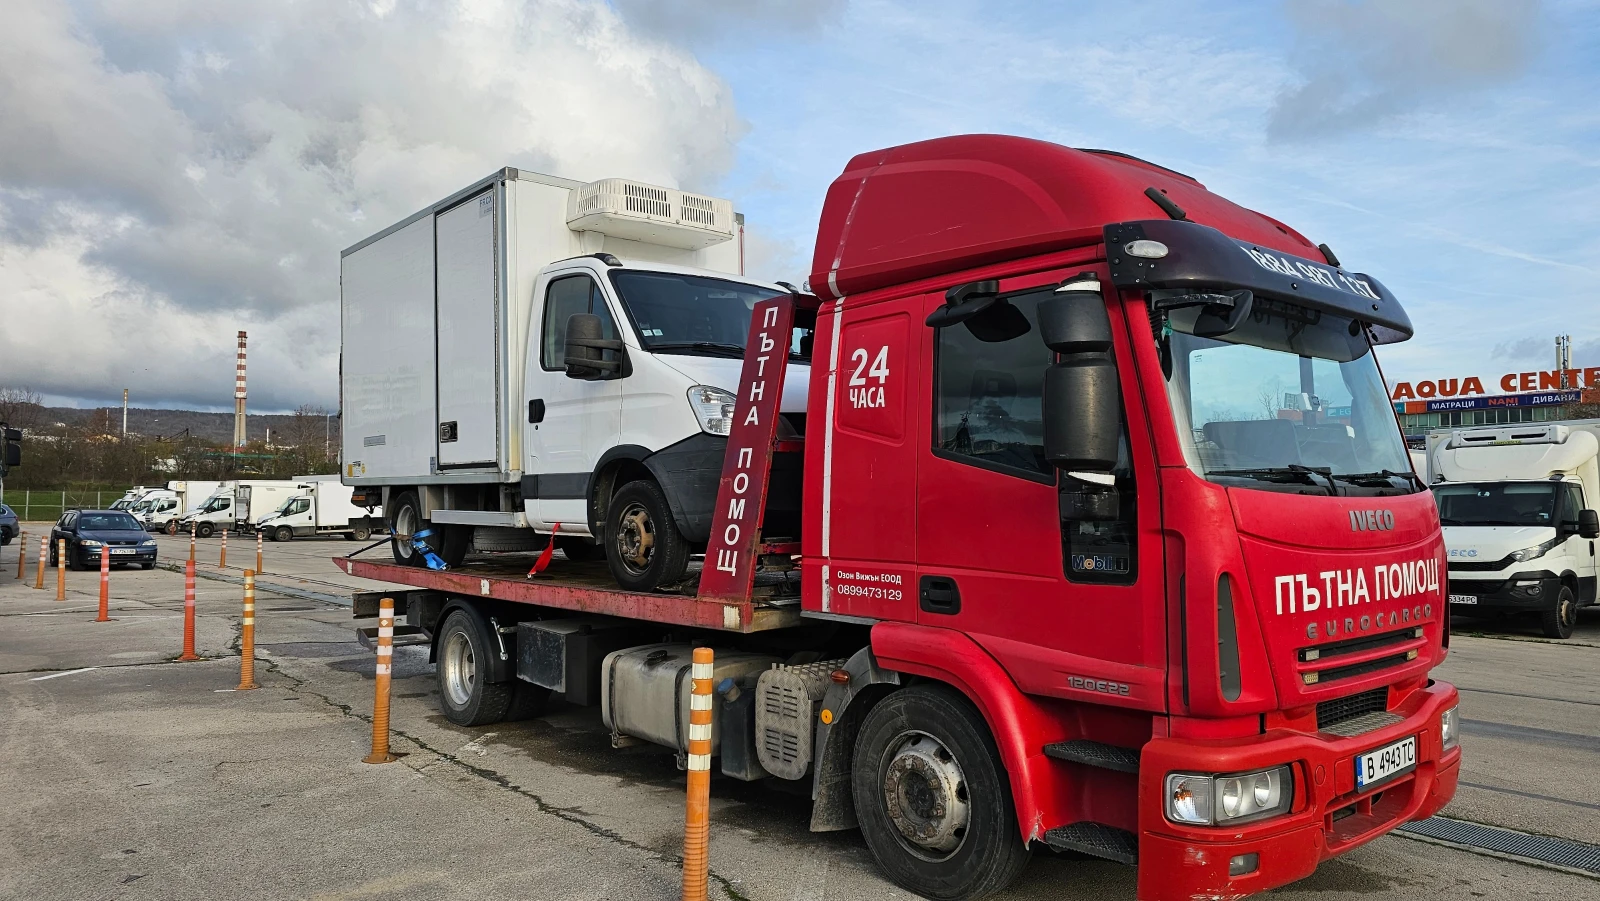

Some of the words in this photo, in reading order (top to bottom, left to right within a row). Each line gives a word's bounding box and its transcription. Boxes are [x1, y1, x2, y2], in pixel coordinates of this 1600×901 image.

[1296, 261, 1341, 290] 987
[1339, 273, 1381, 300] 137
[744, 306, 779, 426] ПЪТНА
[849, 345, 890, 387] 24
[849, 386, 886, 409] ЧАСА
[1392, 377, 1485, 400] AQUA
[1431, 400, 1475, 411] МАТРАЦИ
[716, 447, 753, 576] ПОМОЩ
[1348, 509, 1395, 532] IVECO
[1072, 555, 1113, 571] Mobil
[837, 570, 855, 580] Озон
[855, 573, 880, 582] Вижън
[880, 574, 902, 585] ЕООД
[1275, 567, 1371, 616] ПЪТНА
[1375, 558, 1441, 601] ПОМОЩ
[837, 584, 903, 601] 0899473129
[1306, 603, 1433, 639] EUROCARGO
[1067, 676, 1131, 697] 120E22
